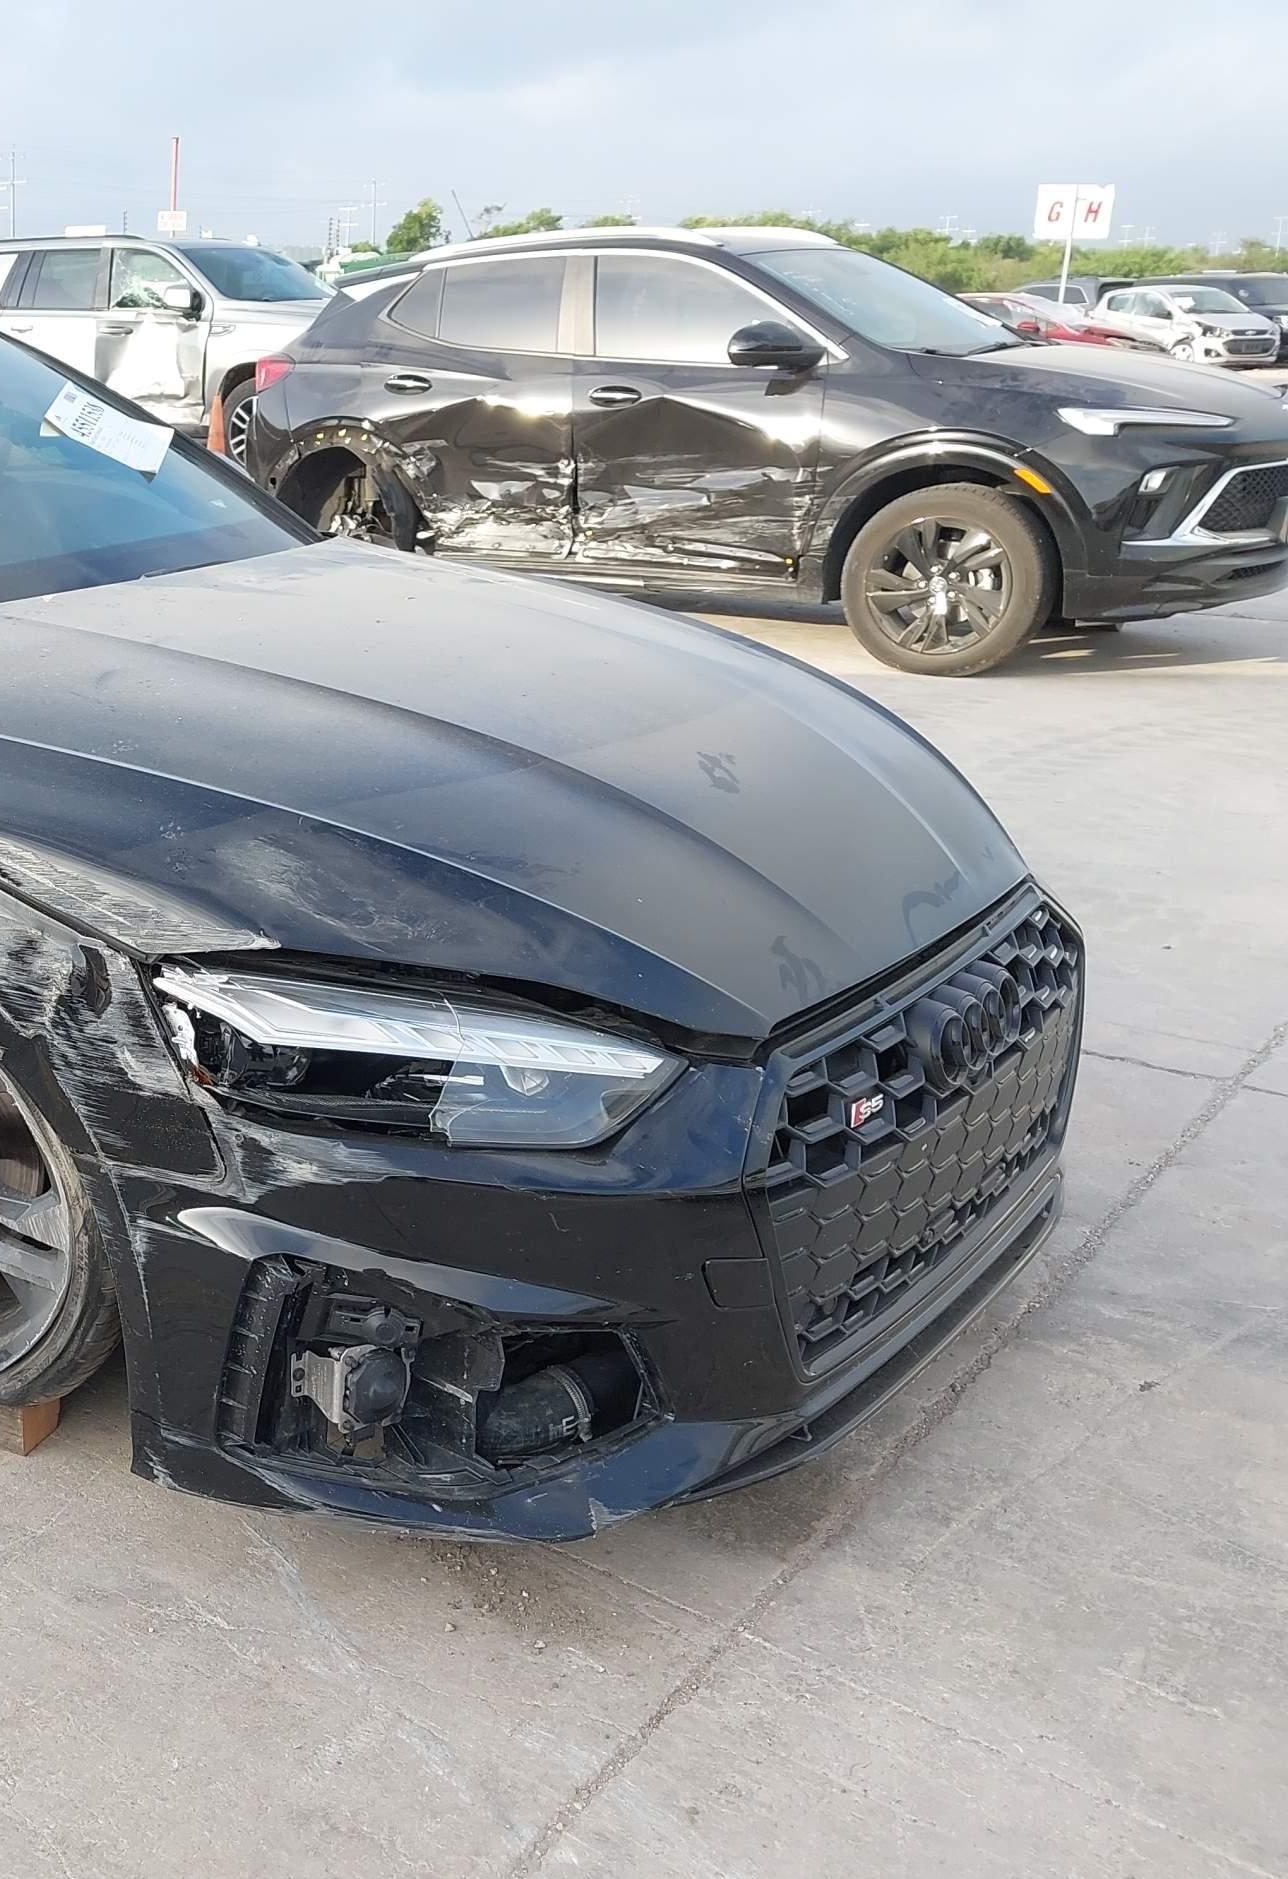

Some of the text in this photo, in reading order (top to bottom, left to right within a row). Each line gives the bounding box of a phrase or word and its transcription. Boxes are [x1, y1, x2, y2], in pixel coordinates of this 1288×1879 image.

[1047, 201, 1063, 222] G
[1084, 201, 1102, 222] H
[858, 1094, 884, 1119] S5
